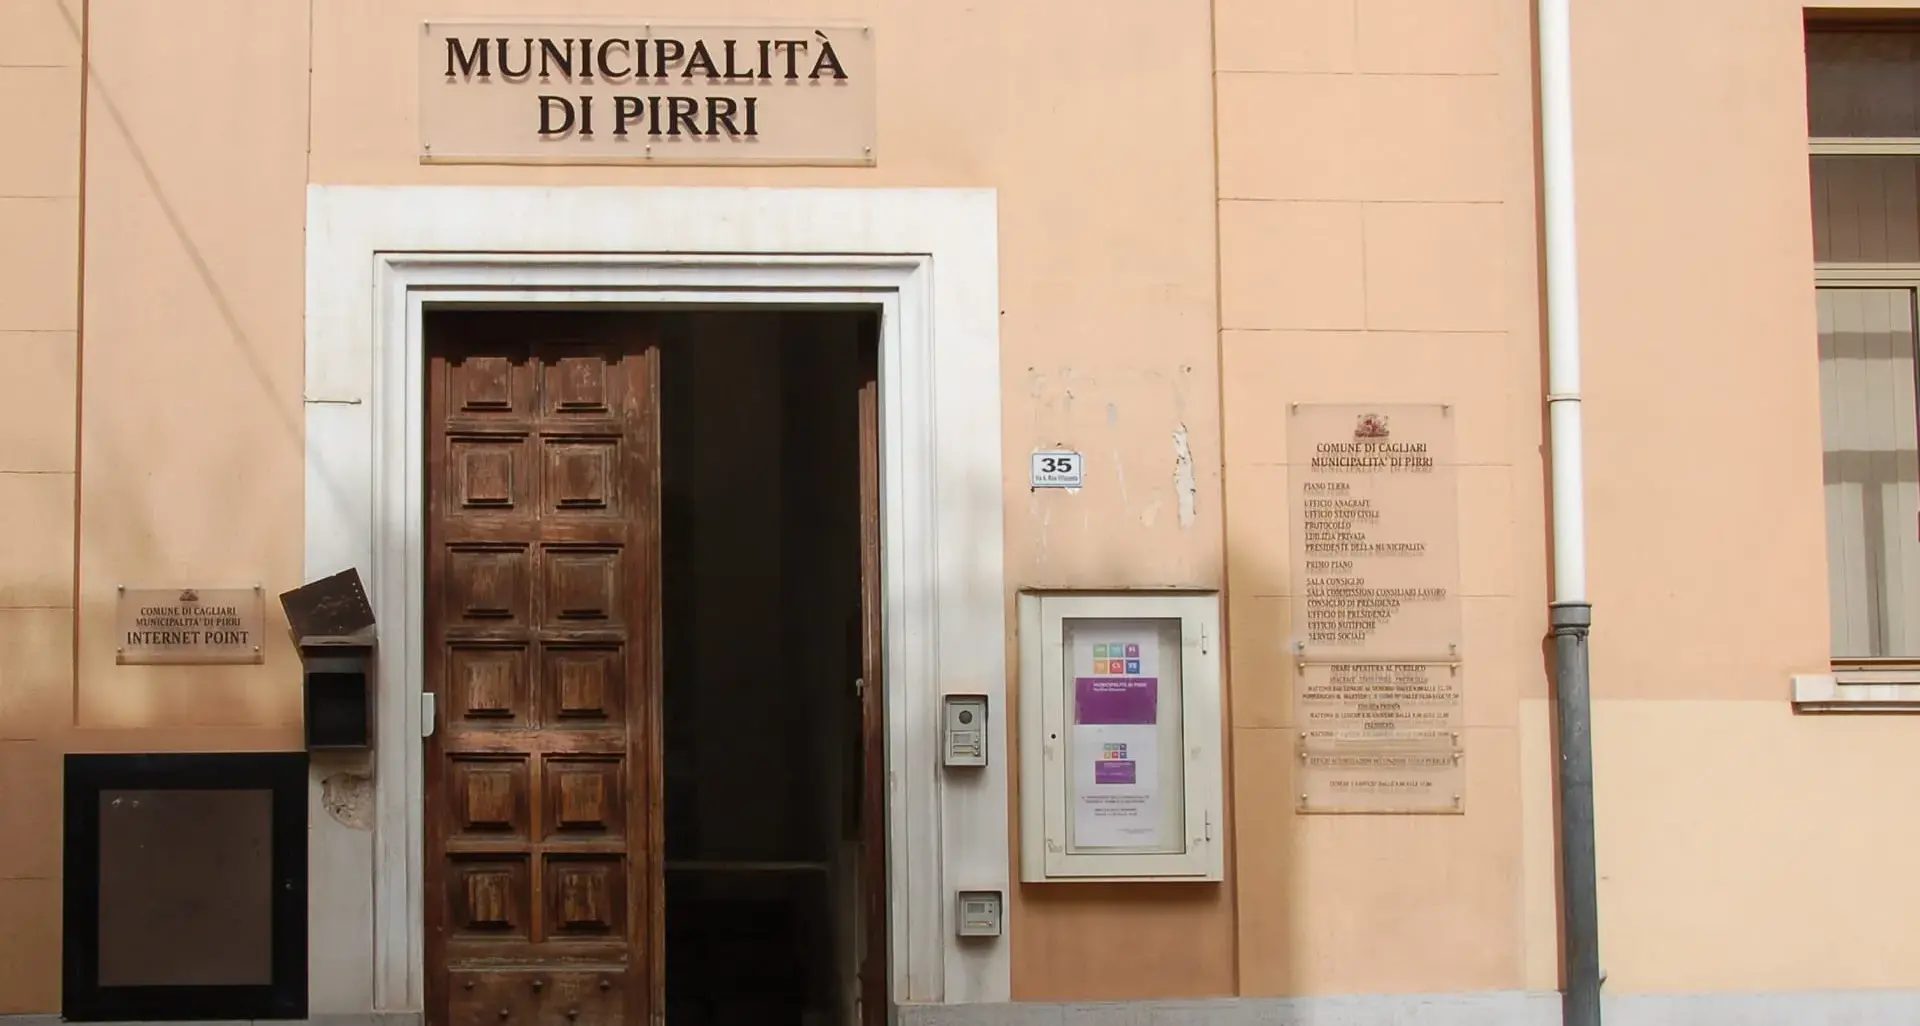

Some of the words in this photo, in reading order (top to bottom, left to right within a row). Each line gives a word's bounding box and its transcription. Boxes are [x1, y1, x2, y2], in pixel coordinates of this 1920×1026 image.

[444, 29, 848, 80] MUNICIPALITÀ
[537, 95, 594, 136] DI
[612, 96, 758, 136] PIRRI
[1316, 442, 1362, 453] COMUNE
[1364, 442, 1376, 453] DI
[1378, 442, 1427, 453] CAGLIARI
[1041, 458, 1072, 473] 35
[1391, 457, 1402, 467] DI
[1405, 457, 1433, 467] PIRRI
[1304, 500, 1332, 508] UFFICIO
[1305, 543, 1349, 551] PRESIDENTE
[1326, 578, 1365, 586] CONSIGLIO
[1307, 600, 1346, 608] CONSIGLIO
[140, 607, 179, 616] COMUNE
[182, 607, 192, 616] DI
[194, 607, 236, 616] CAGLIARI
[1307, 610, 1336, 618] UFFICIO
[204, 617, 214, 627] DI
[216, 617, 241, 627] PIRRI
[127, 631, 200, 645] INTERNET
[204, 631, 249, 645] POINT
